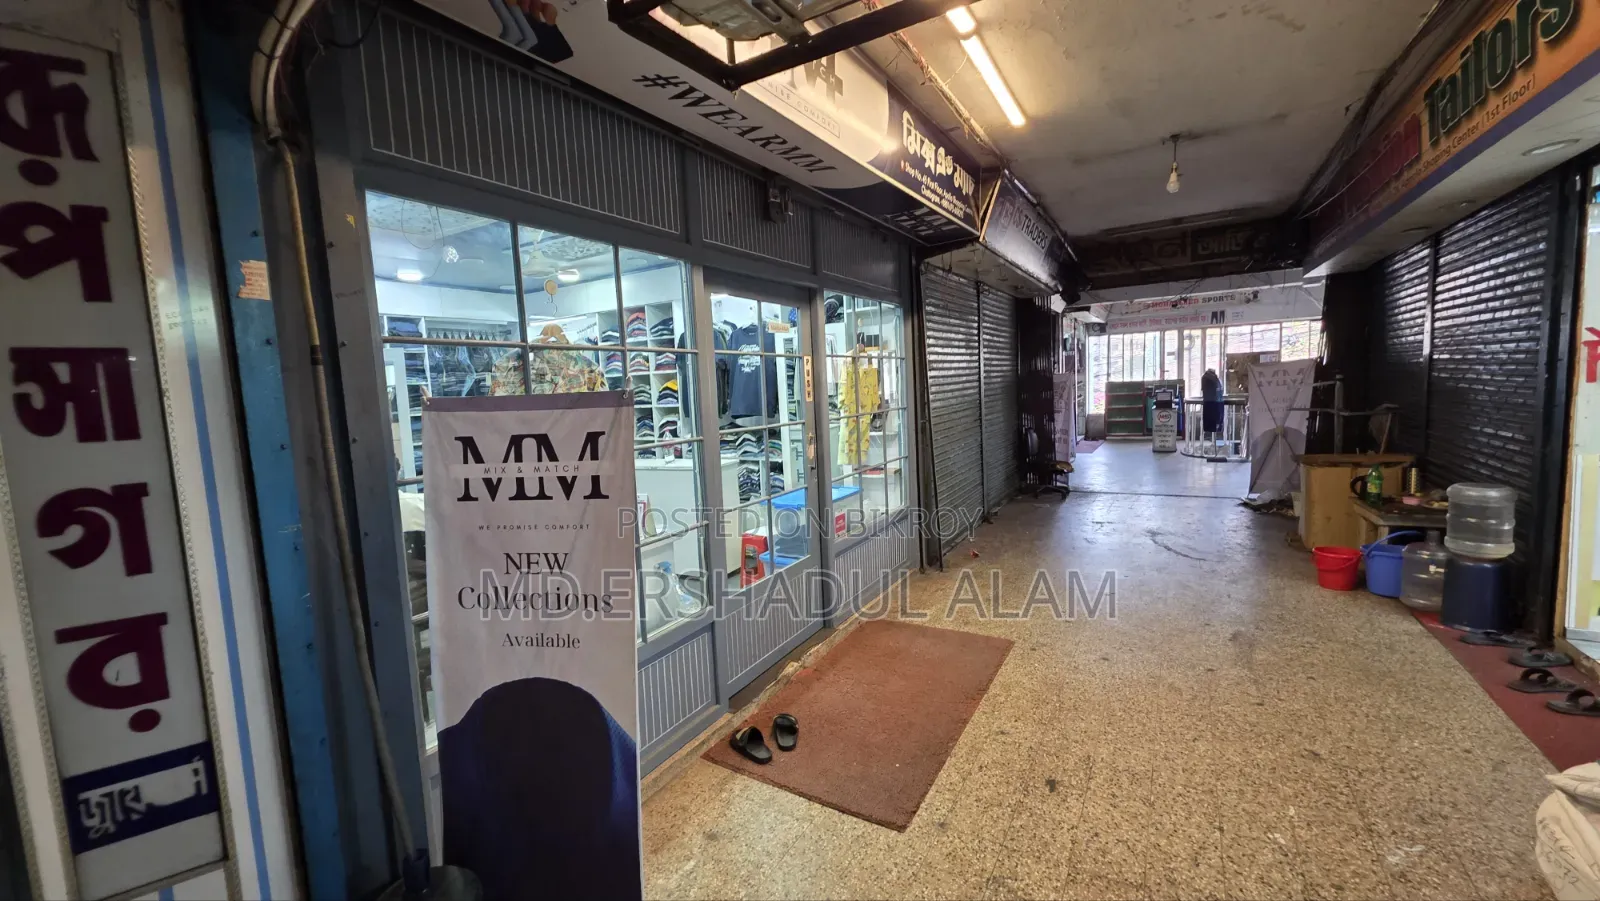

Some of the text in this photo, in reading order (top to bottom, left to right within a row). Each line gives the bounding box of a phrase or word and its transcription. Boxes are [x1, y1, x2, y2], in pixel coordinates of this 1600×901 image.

[631, 73, 838, 173] #WEARMM
[1452, 121, 1480, 148] Center
[1020, 214, 1049, 250] TRADERS
[1201, 294, 1236, 304] SPORTS
[483, 464, 581, 475] MIX & MATCH
[478, 522, 591, 532] WE PROMISE COMFORT
[503, 552, 570, 576] NEW
[457, 586, 615, 615] Collections
[502, 631, 581, 650] Available
